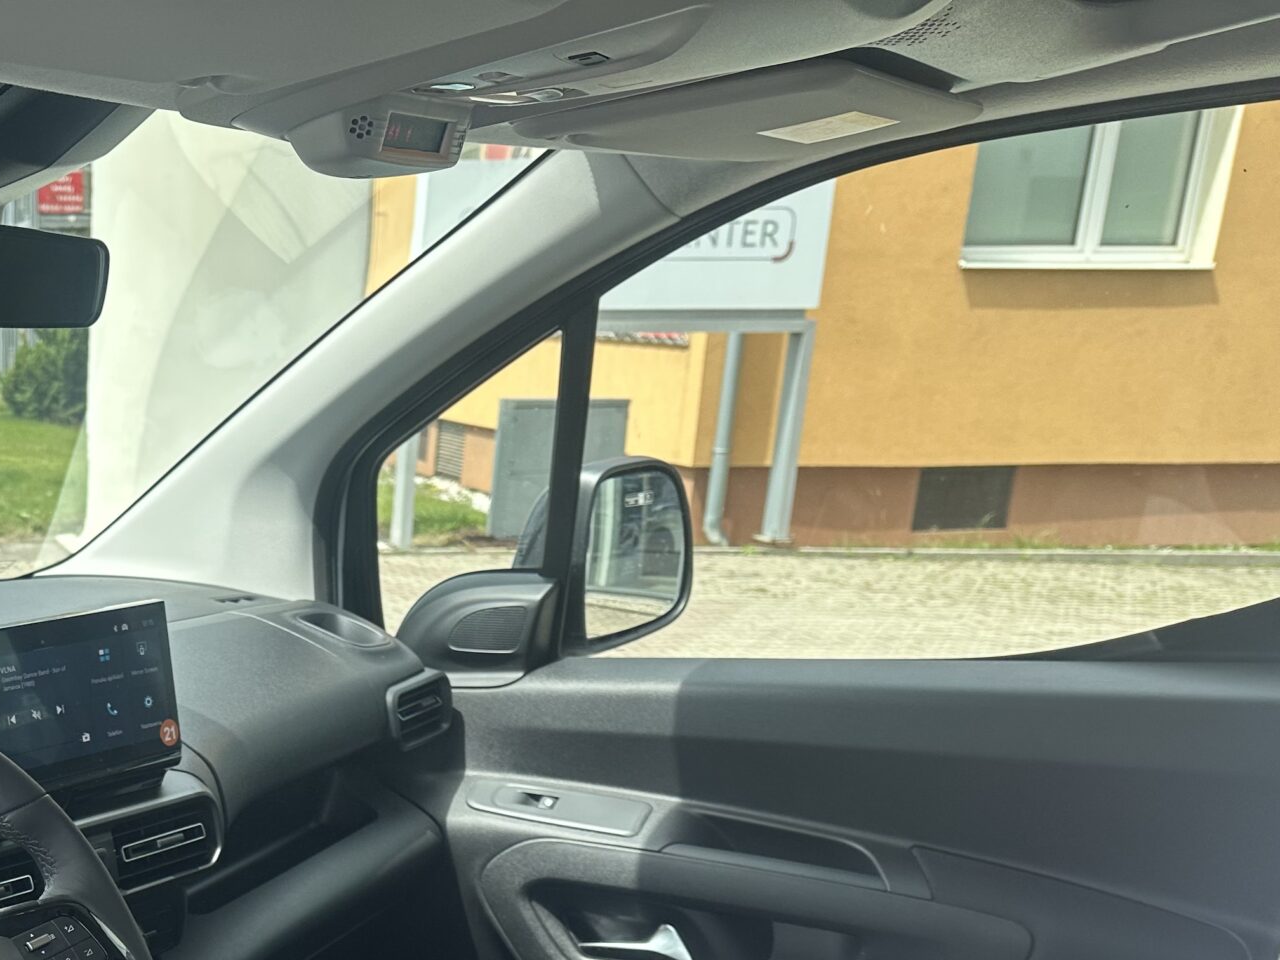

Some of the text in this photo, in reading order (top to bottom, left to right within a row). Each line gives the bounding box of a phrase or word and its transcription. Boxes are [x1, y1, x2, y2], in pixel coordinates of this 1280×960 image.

[686, 219, 780, 249] NTER
[0, 665, 16, 675] VLNA
[163, 726, 176, 741] 21
